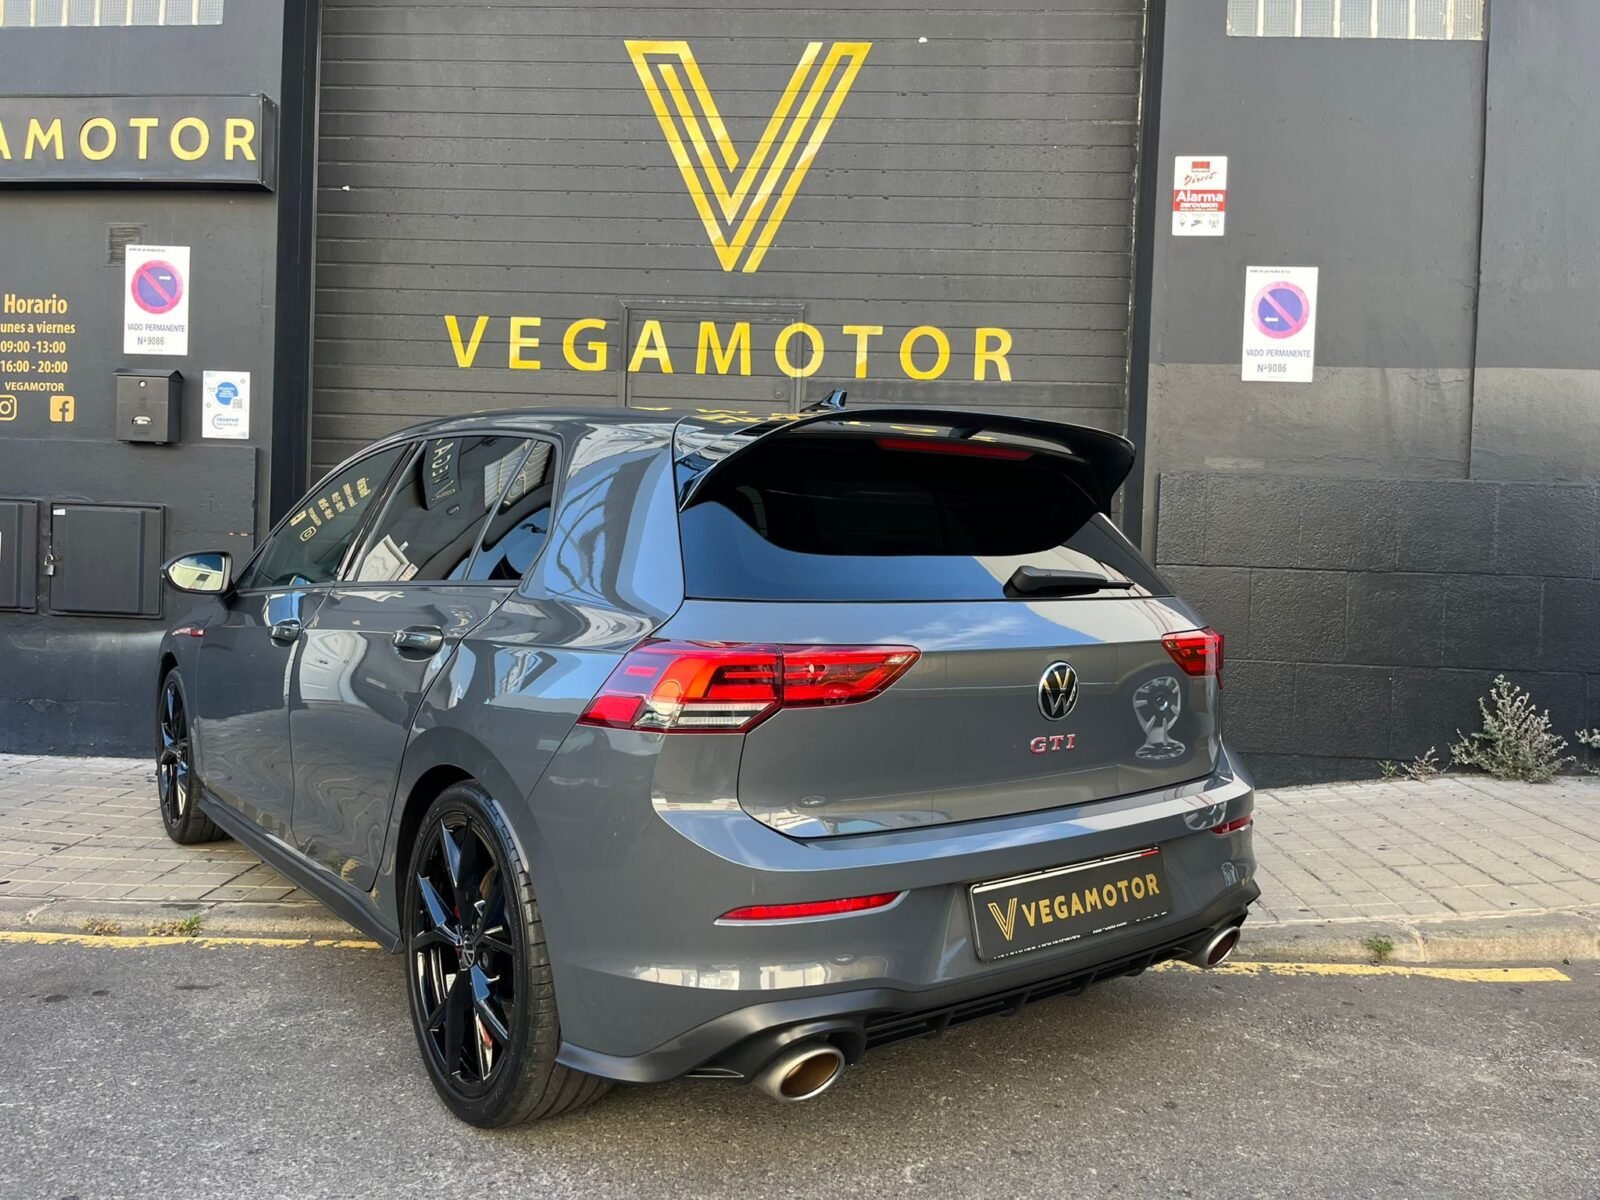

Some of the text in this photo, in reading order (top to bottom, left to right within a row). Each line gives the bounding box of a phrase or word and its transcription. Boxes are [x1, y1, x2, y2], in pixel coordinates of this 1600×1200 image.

[1175, 190, 1224, 203] Alarma
[4, 293, 68, 314] Horario
[27, 323, 34, 333] a
[36, 321, 76, 334] viernes
[127, 323, 186, 333] VADO PERMANENTE
[444, 315, 1014, 382] VEGAMOTOR
[1246, 349, 1312, 359] VADO PERMANENTE
[0, 360, 30, 373] 16:00
[38, 361, 68, 373] 20:00
[4, 382, 64, 392] VEGAMOTOR
[1030, 733, 1076, 754] GTI
[1021, 873, 1160, 928] VEGAMOTOR
